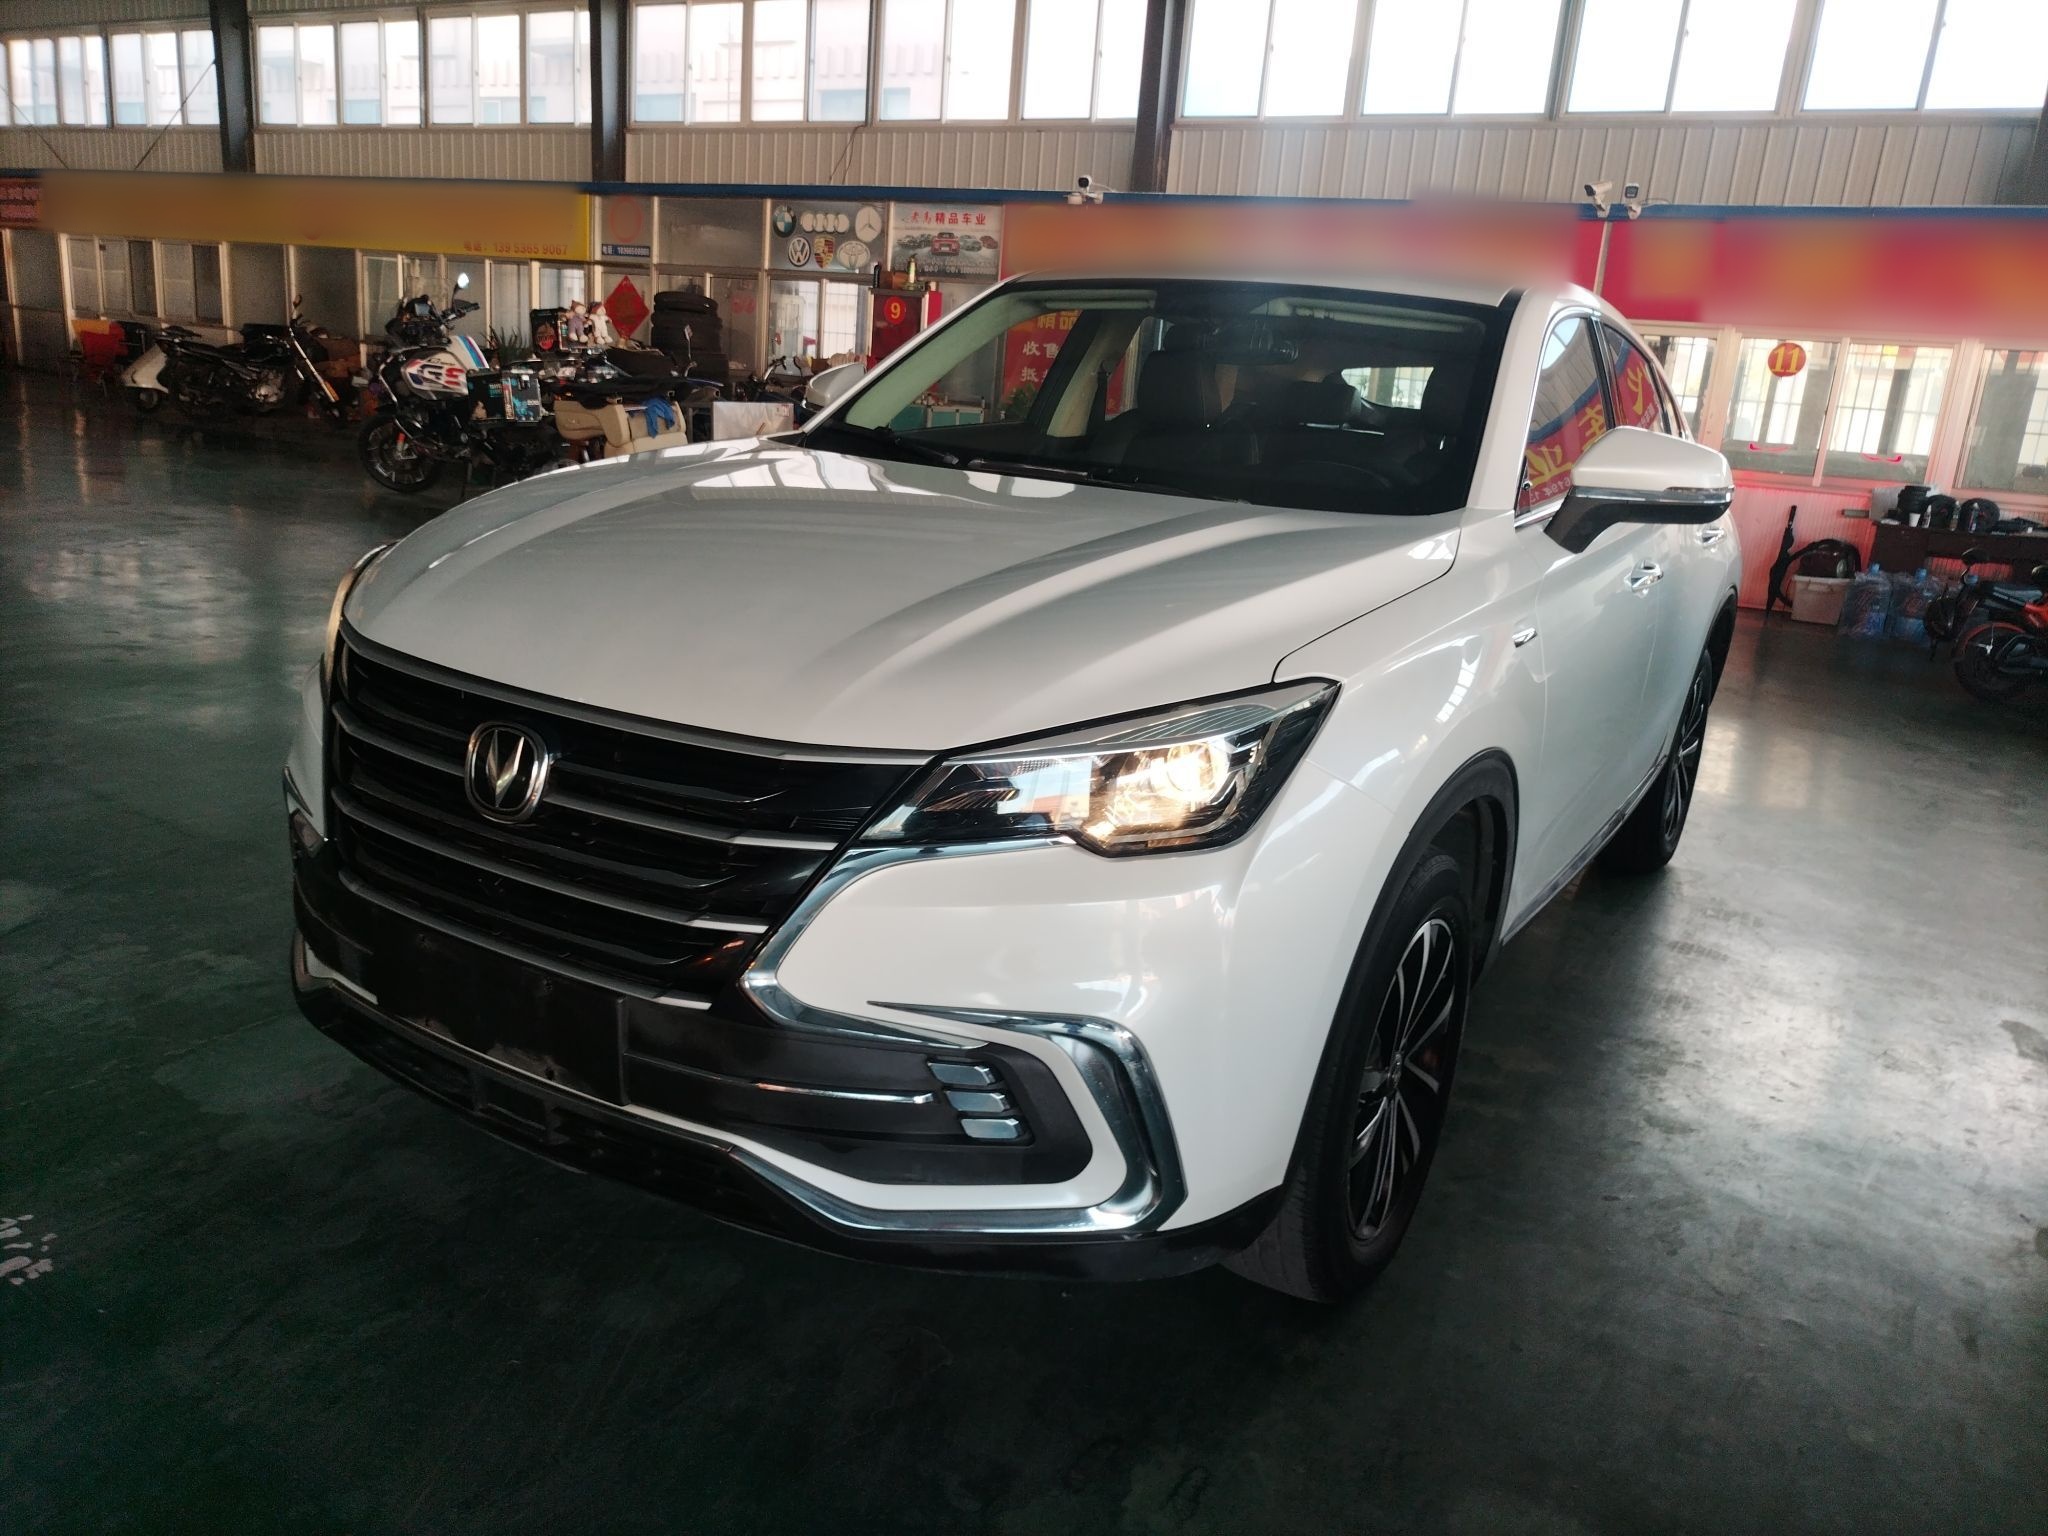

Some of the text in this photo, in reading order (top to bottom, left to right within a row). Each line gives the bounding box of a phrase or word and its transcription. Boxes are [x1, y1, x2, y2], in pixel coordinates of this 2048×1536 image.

[543, 244, 568, 256] 9067
[890, 302, 900, 319] 9
[1771, 346, 1801, 373] 11
